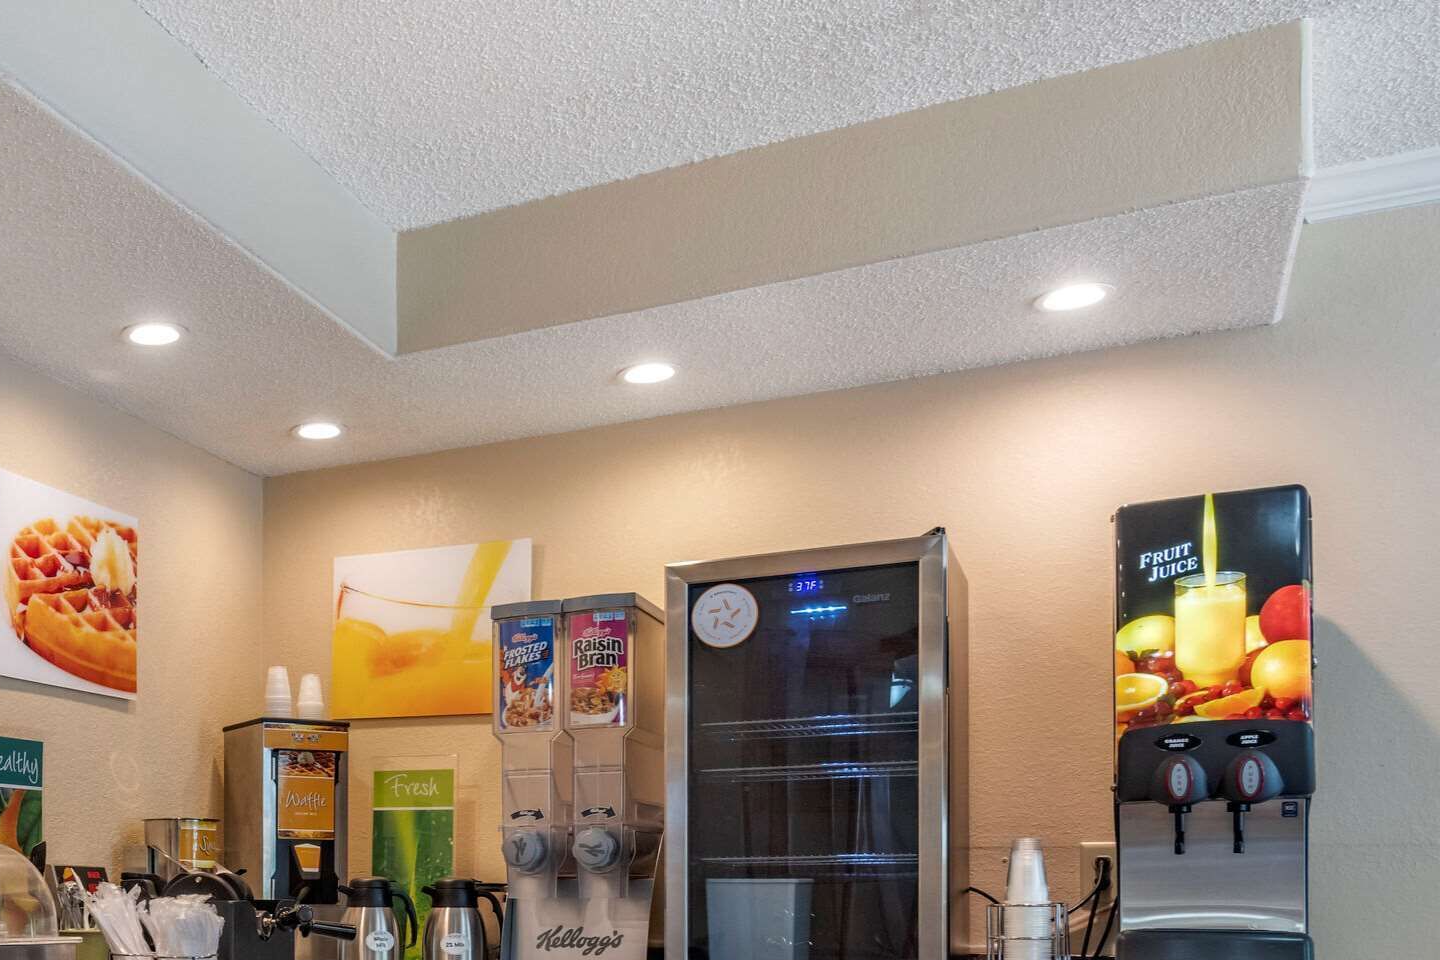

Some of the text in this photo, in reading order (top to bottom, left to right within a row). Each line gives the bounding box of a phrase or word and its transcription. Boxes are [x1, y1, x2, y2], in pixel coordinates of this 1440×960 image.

[1139, 542, 1192, 570] FRUIT
[1148, 556, 1199, 582] JUICE
[503, 641, 548, 660] FROSTED
[572, 636, 624, 658] Raisin
[504, 650, 541, 669] FLAKES
[577, 650, 617, 671] Bran
[383, 773, 440, 798] Fresh
[285, 790, 327, 809] Waffle
[536, 924, 624, 956] Kellogg's
